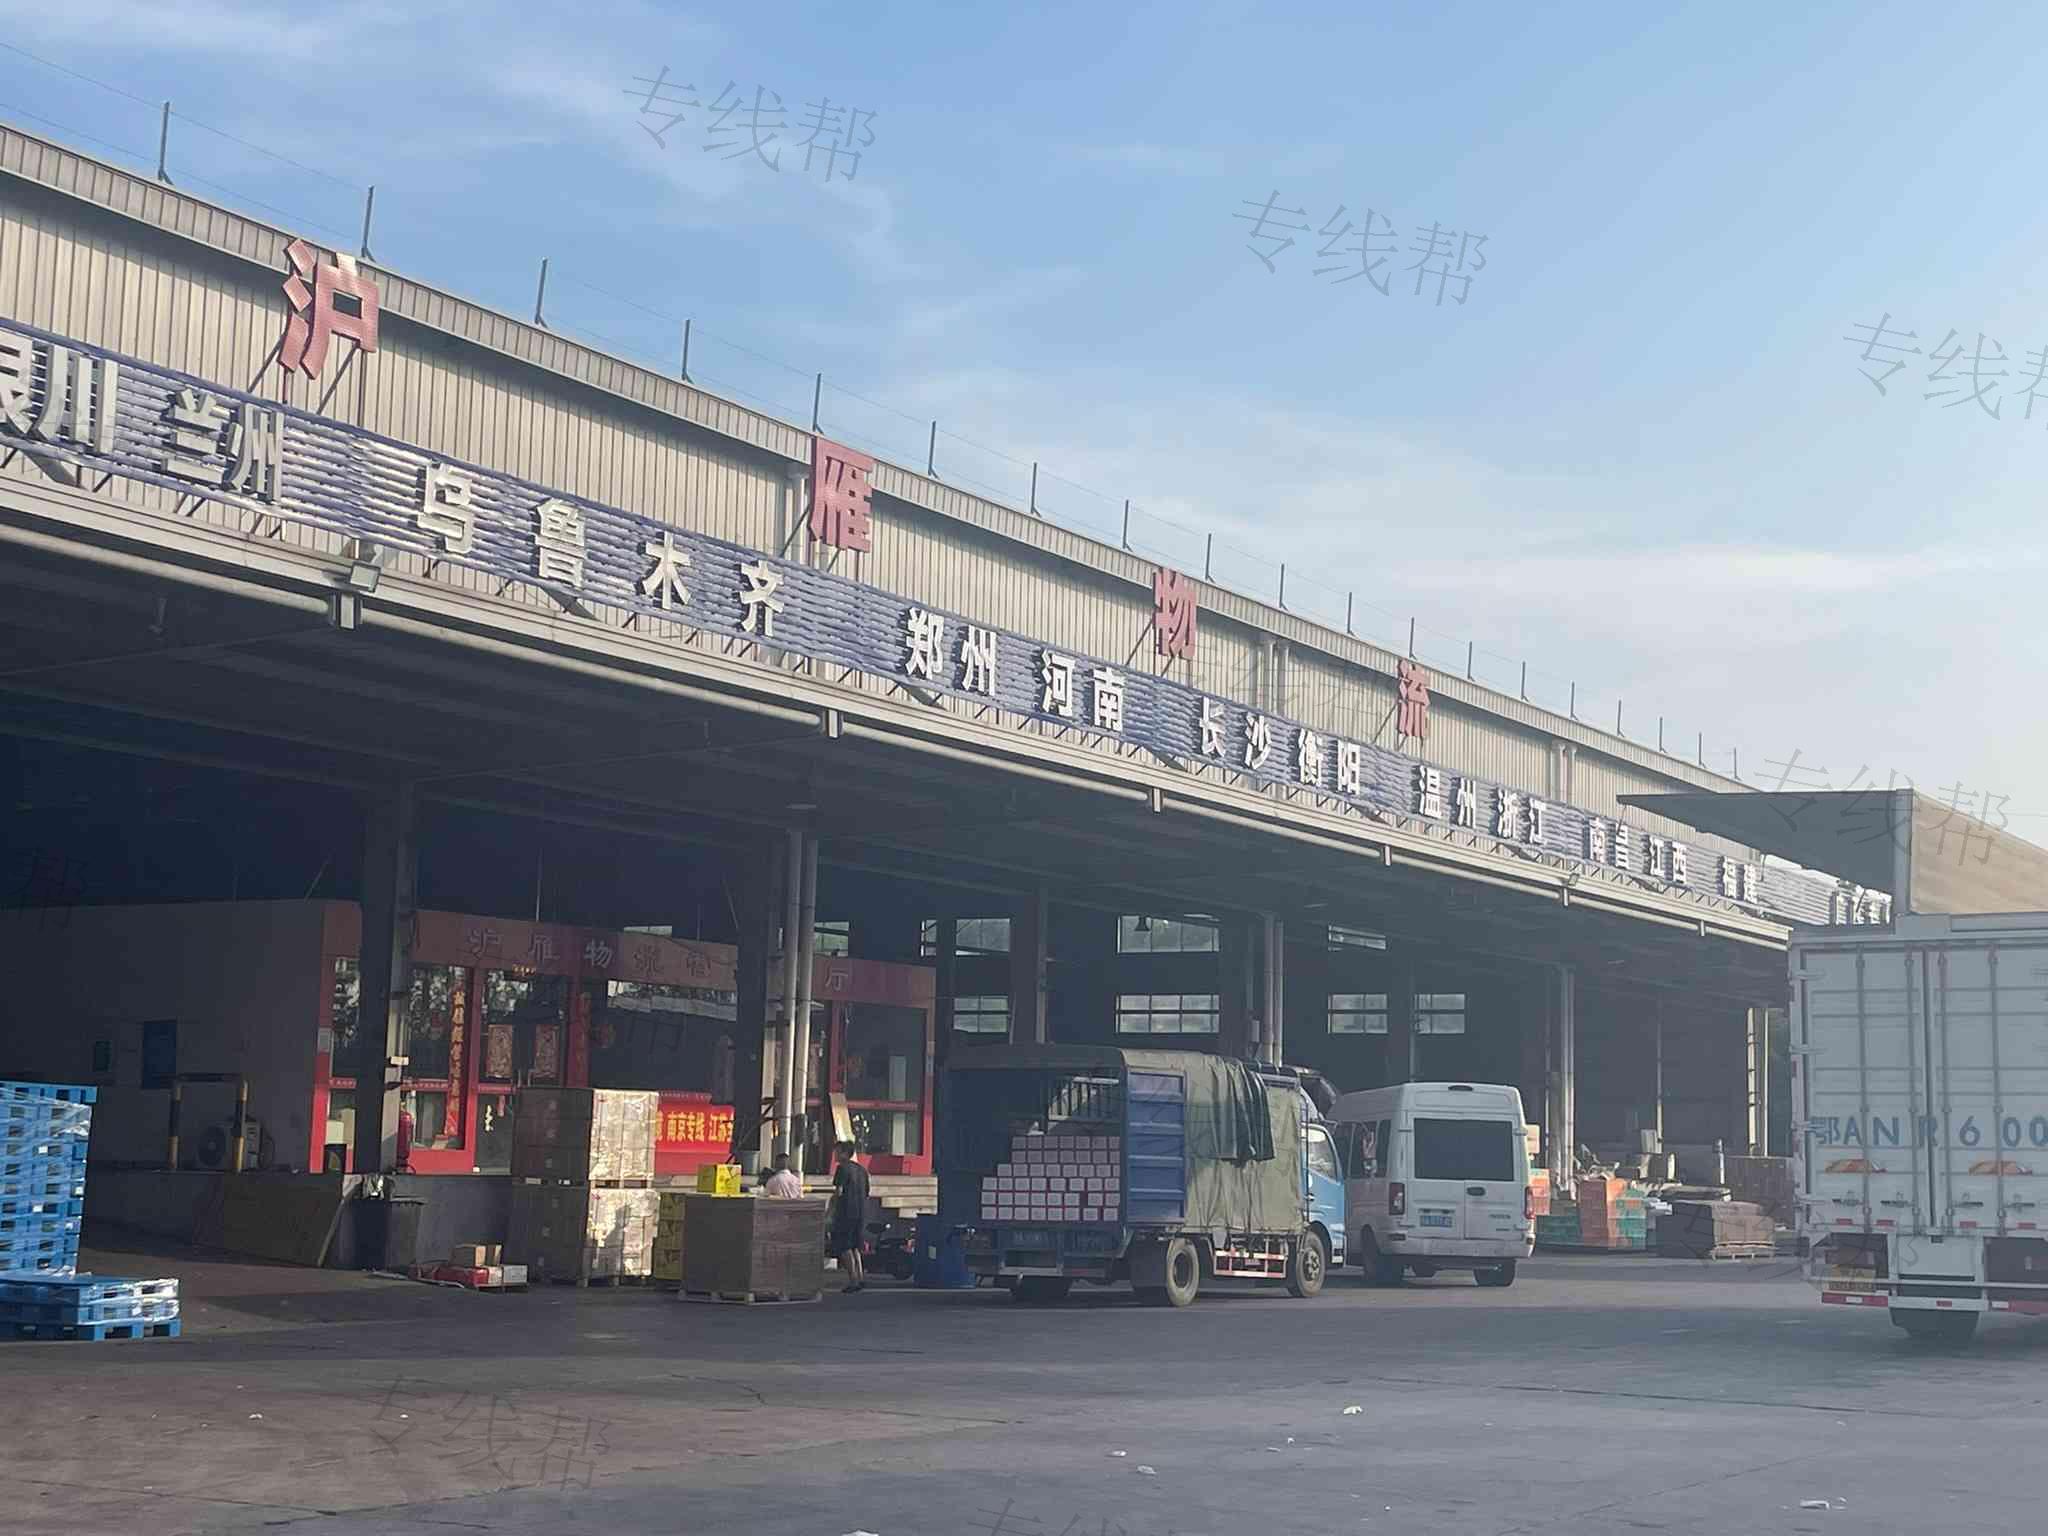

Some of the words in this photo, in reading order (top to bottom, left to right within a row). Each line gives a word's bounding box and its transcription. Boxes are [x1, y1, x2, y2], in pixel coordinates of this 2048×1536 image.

[163, 387, 285, 502] 兰州
[905, 607, 998, 696] 郑州
[1041, 650, 1125, 733] 河南
[282, 238, 379, 380] 沪
[807, 436, 876, 553] 雁
[1152, 569, 1198, 660] 物
[1397, 660, 1431, 737] 流
